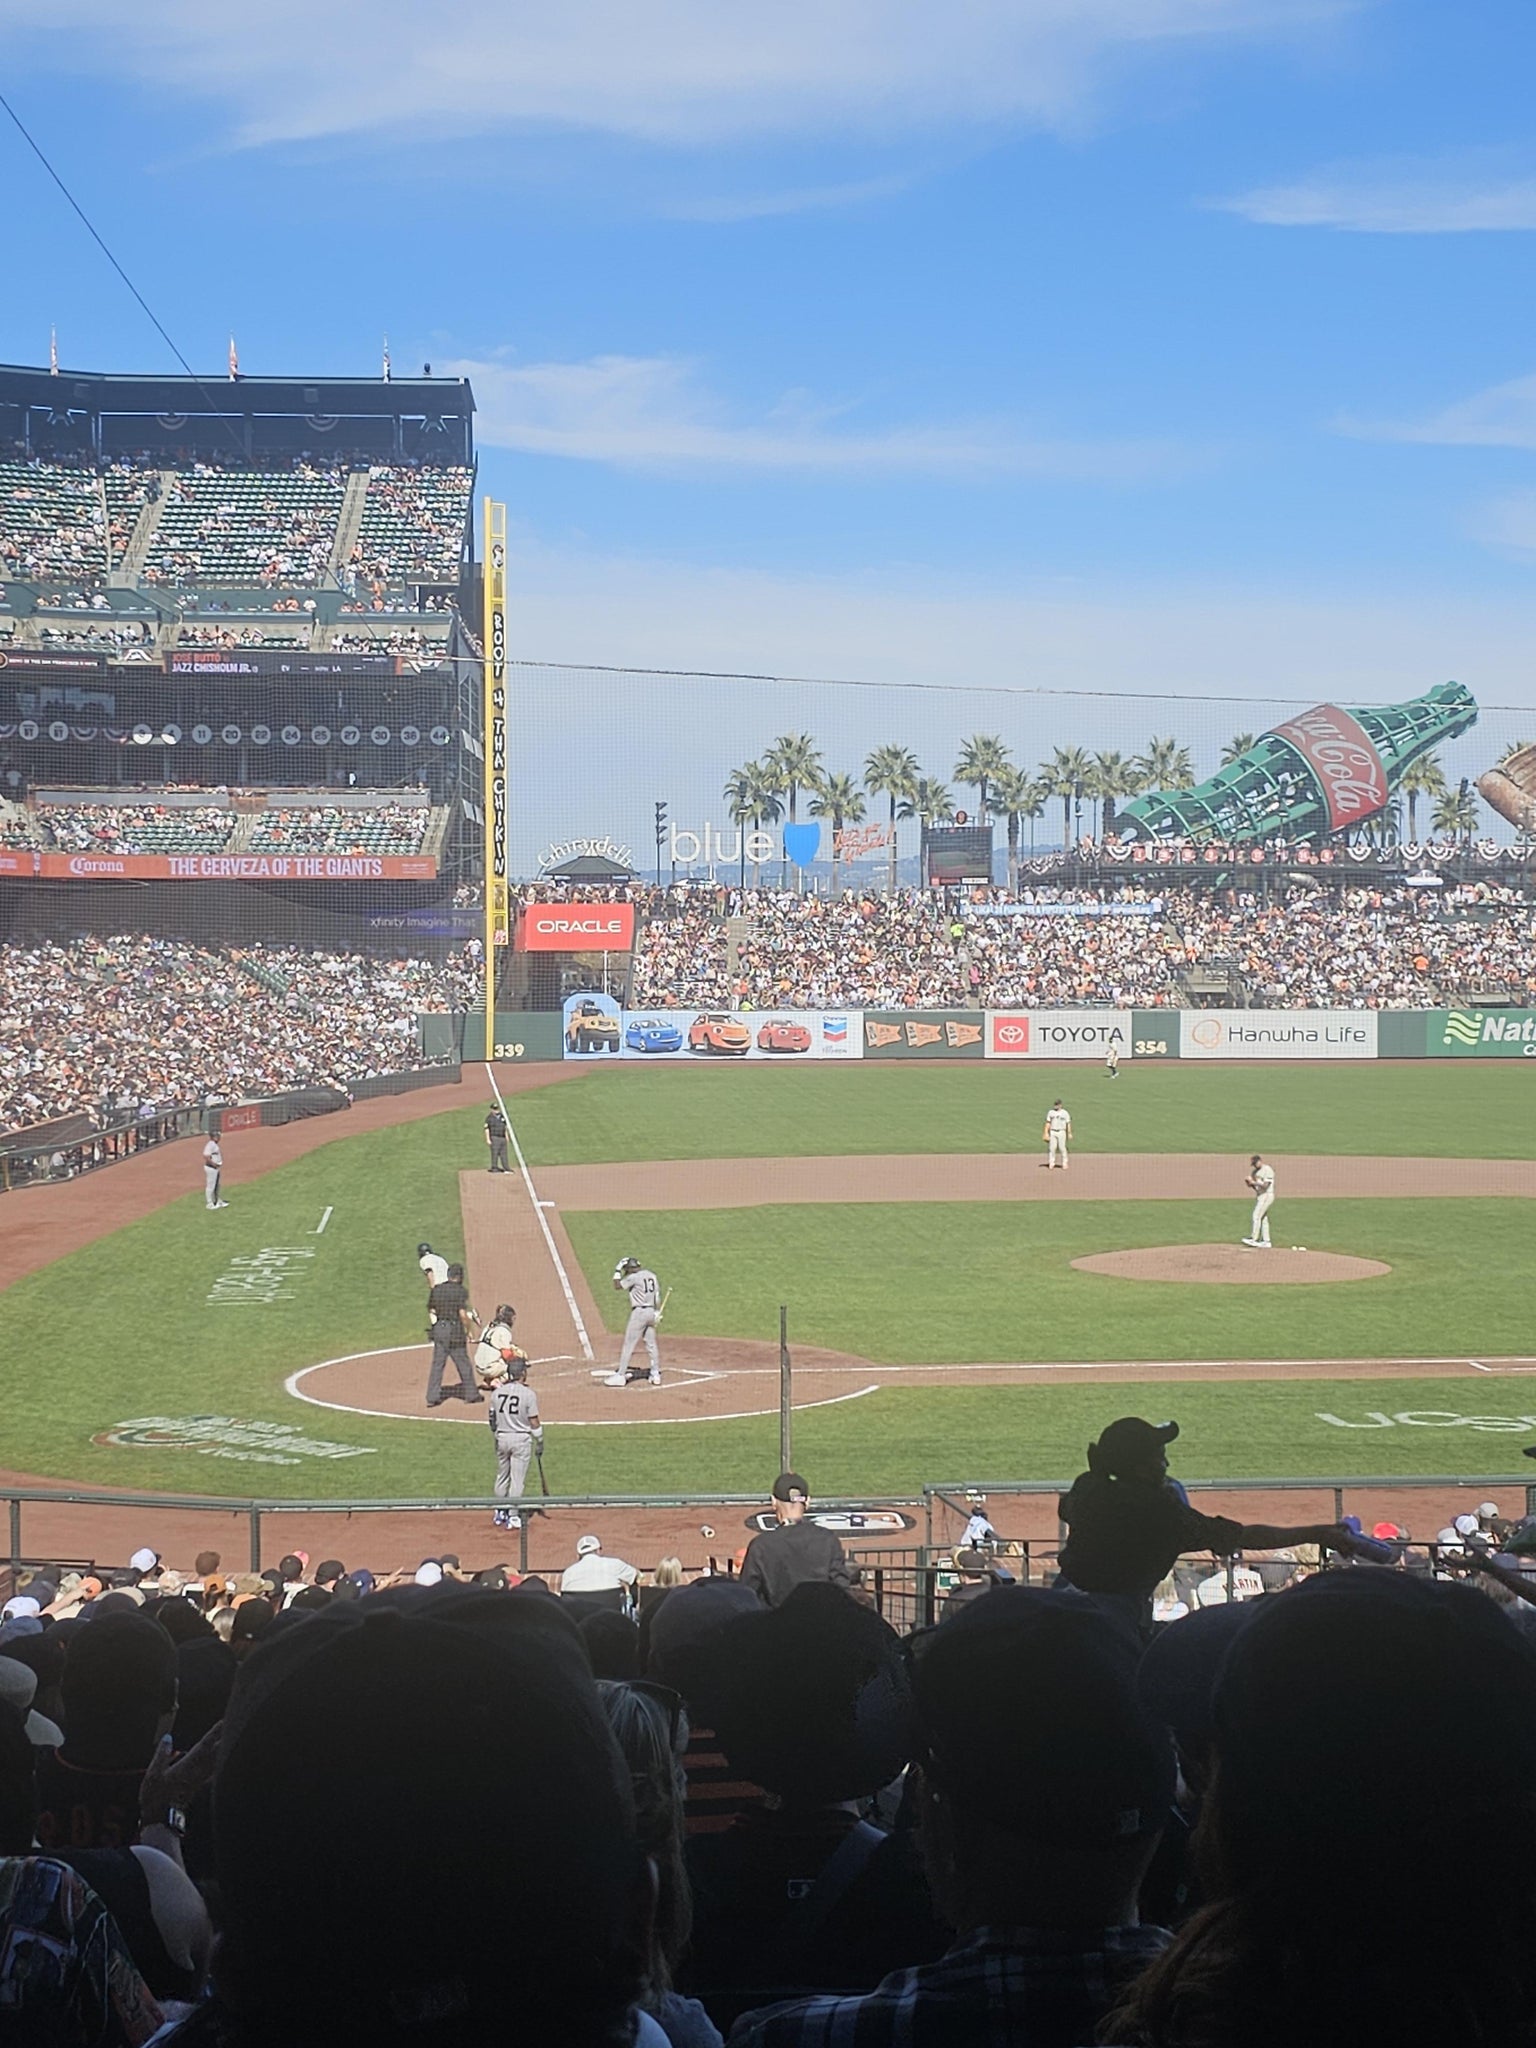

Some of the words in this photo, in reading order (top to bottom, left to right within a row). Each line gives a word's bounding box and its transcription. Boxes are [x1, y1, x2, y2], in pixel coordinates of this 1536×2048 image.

[493, 611, 505, 679] ROOT
[172, 662, 193, 673] JAZZ
[194, 662, 238, 673] CHISHOLM
[493, 688, 505, 710] 4
[493, 718, 506, 771] THA
[493, 778, 506, 876] CHIKIN
[671, 821, 775, 864] blue
[537, 836, 633, 869] Ghirardelli
[69, 857, 125, 876] Corona
[168, 858, 198, 876] THE
[201, 858, 268, 877] CERVEZA
[272, 858, 292, 876] OF
[294, 858, 323, 876] THE
[327, 858, 383, 877] GIANTS
[536, 920, 622, 933] ORACLE
[1038, 1027, 1124, 1042] TOYOTA
[1229, 1026, 1318, 1042] Hanwha
[1325, 1026, 1366, 1042] Life
[494, 1044, 526, 1058] 339
[1134, 1040, 1168, 1055] 354
[227, 1110, 257, 1128] ORACLE
[643, 1278, 656, 1294] 13
[497, 1393, 521, 1415] 72
